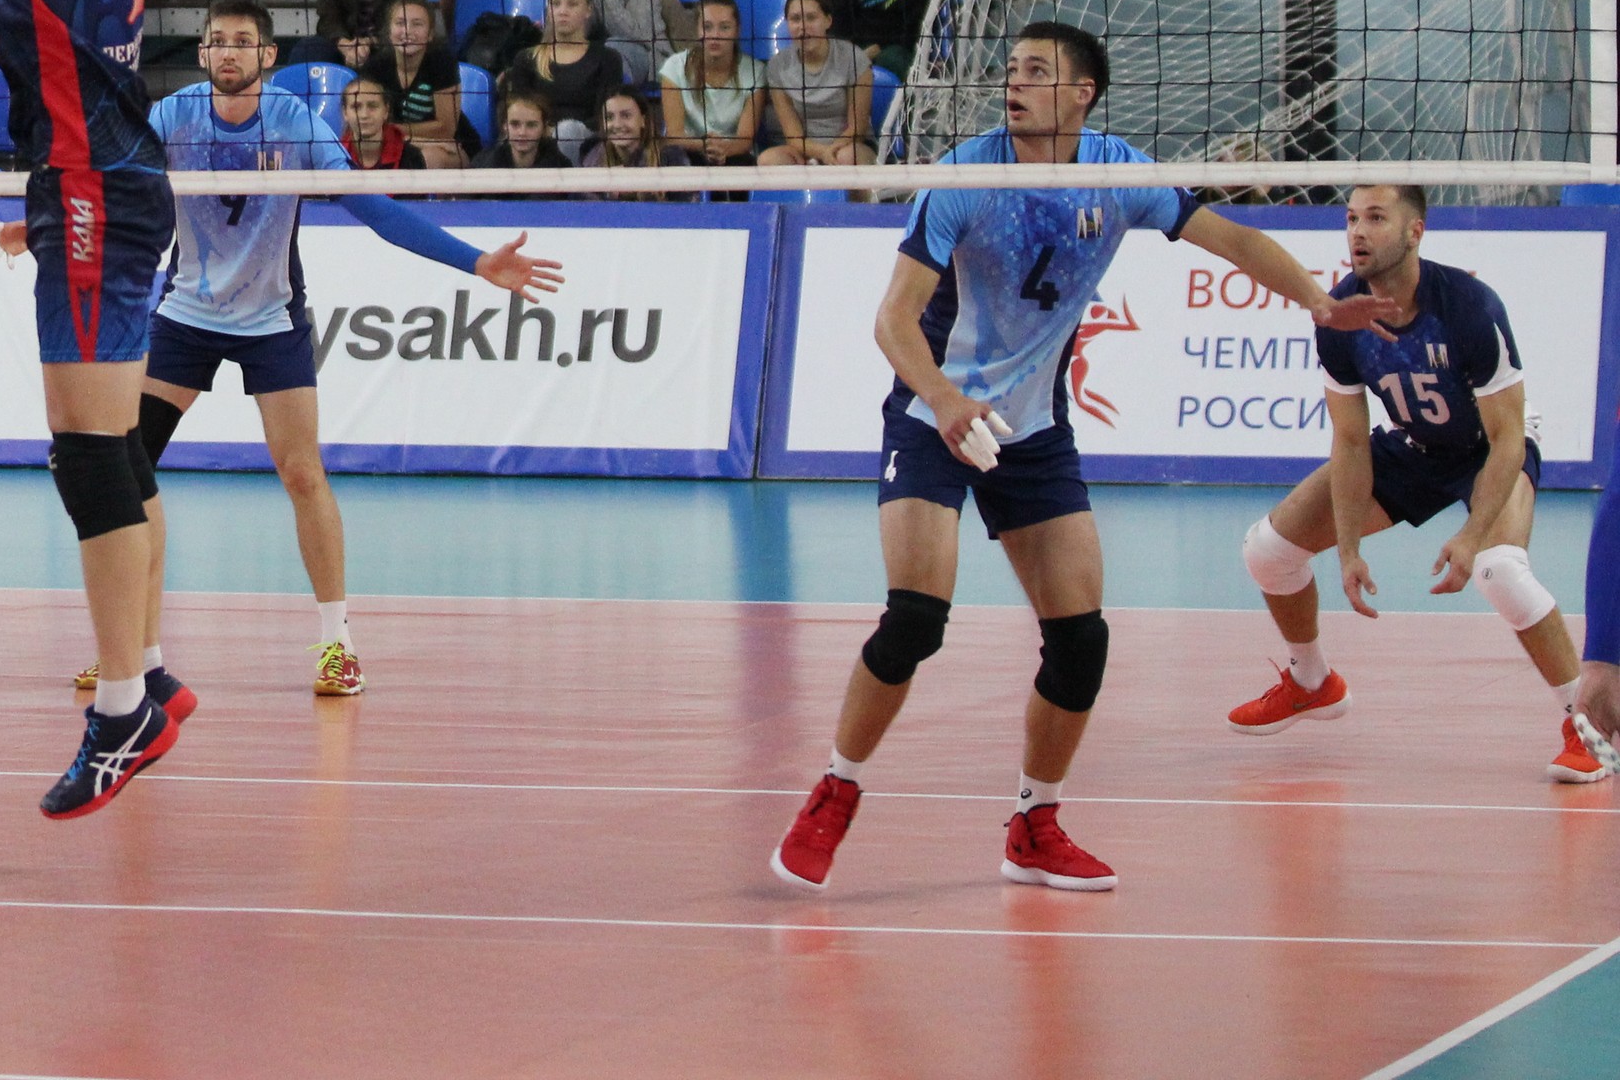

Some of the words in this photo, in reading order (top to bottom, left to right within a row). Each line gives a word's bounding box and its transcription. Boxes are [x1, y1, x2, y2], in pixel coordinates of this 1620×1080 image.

[1019, 245, 1060, 312] 4
[1183, 336, 1324, 370] ЧЕМП
[1378, 371, 1451, 425] 15
[884, 449, 899, 483] 4
